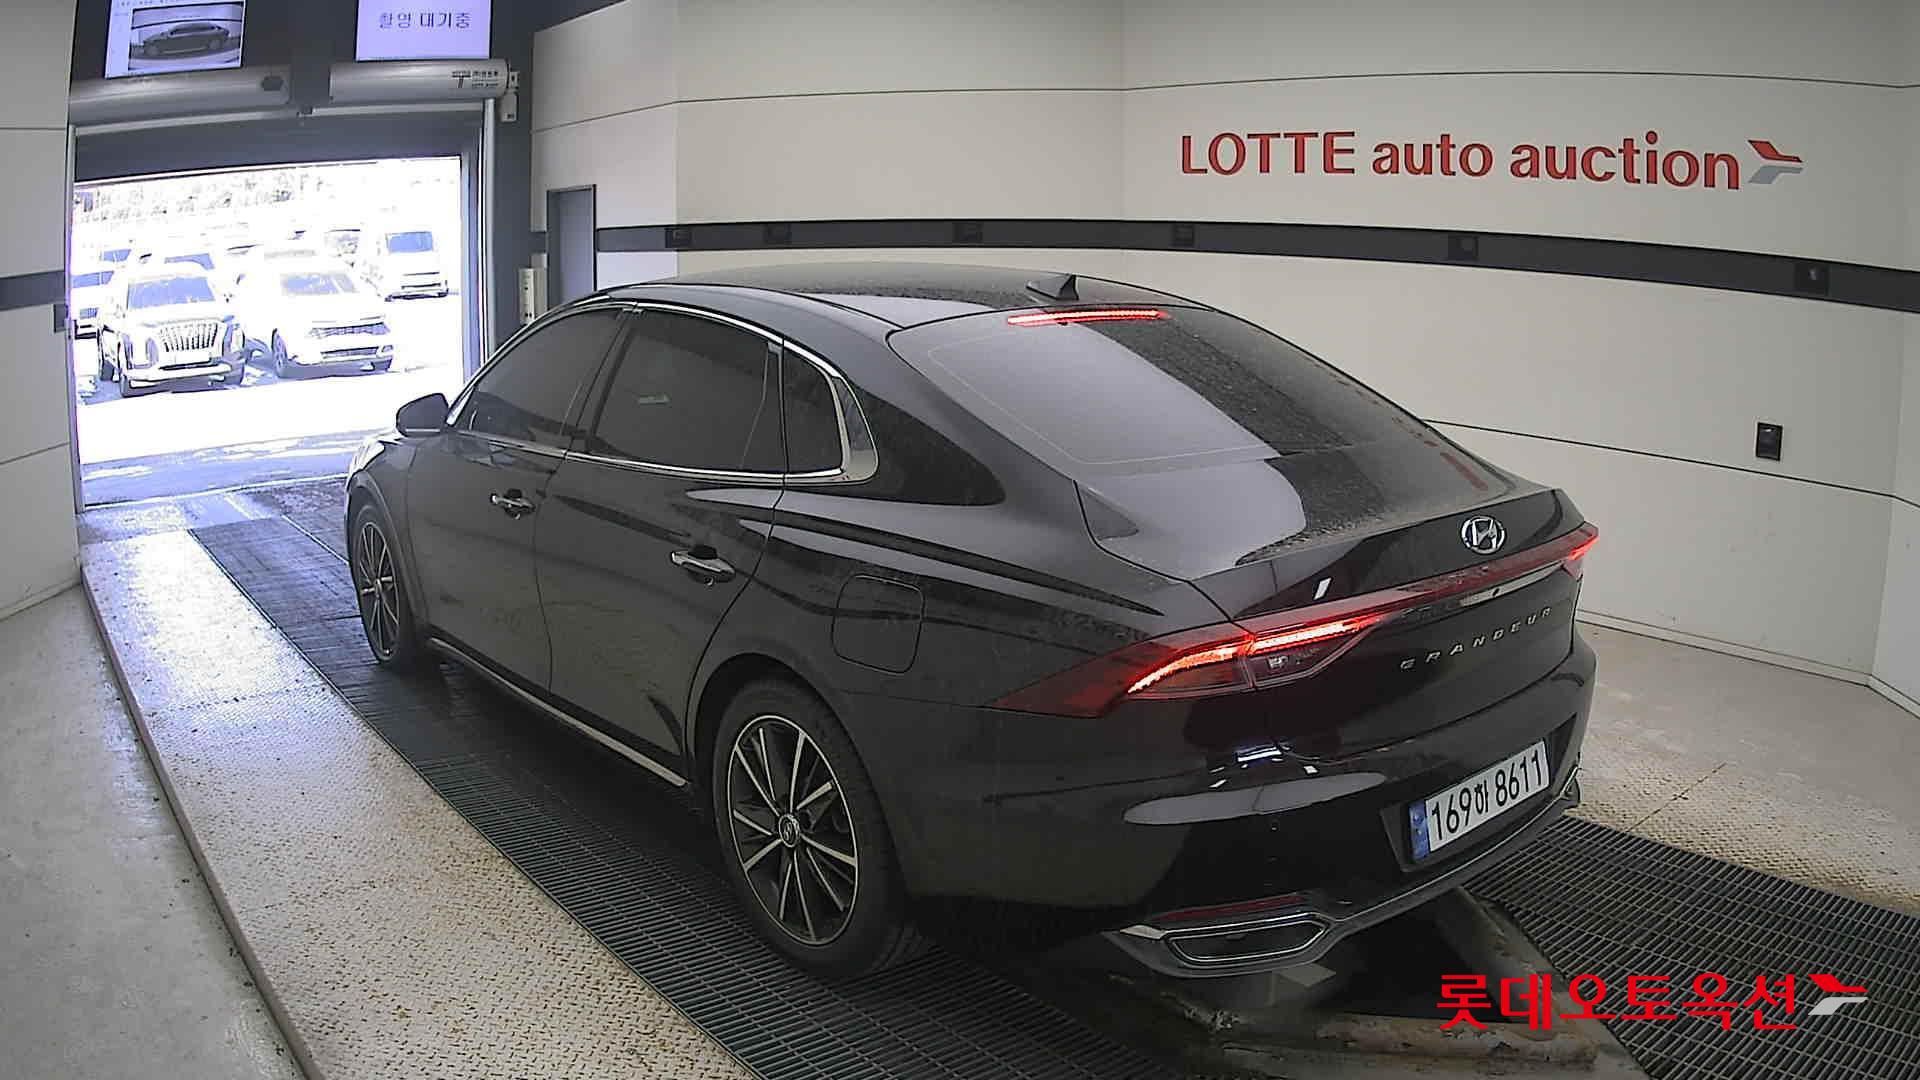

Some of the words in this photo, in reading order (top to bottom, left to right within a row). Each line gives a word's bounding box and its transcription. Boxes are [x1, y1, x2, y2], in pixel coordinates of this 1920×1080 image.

[420, 12, 472, 29] 대기중
[1181, 131, 1356, 176] LOTTE
[1372, 133, 1494, 178] auto
[1510, 130, 1740, 190] auction
[1400, 607, 1551, 670] GRANDEUR
[1431, 779, 1489, 841] 169하
[1495, 749, 1542, 807] 8611
